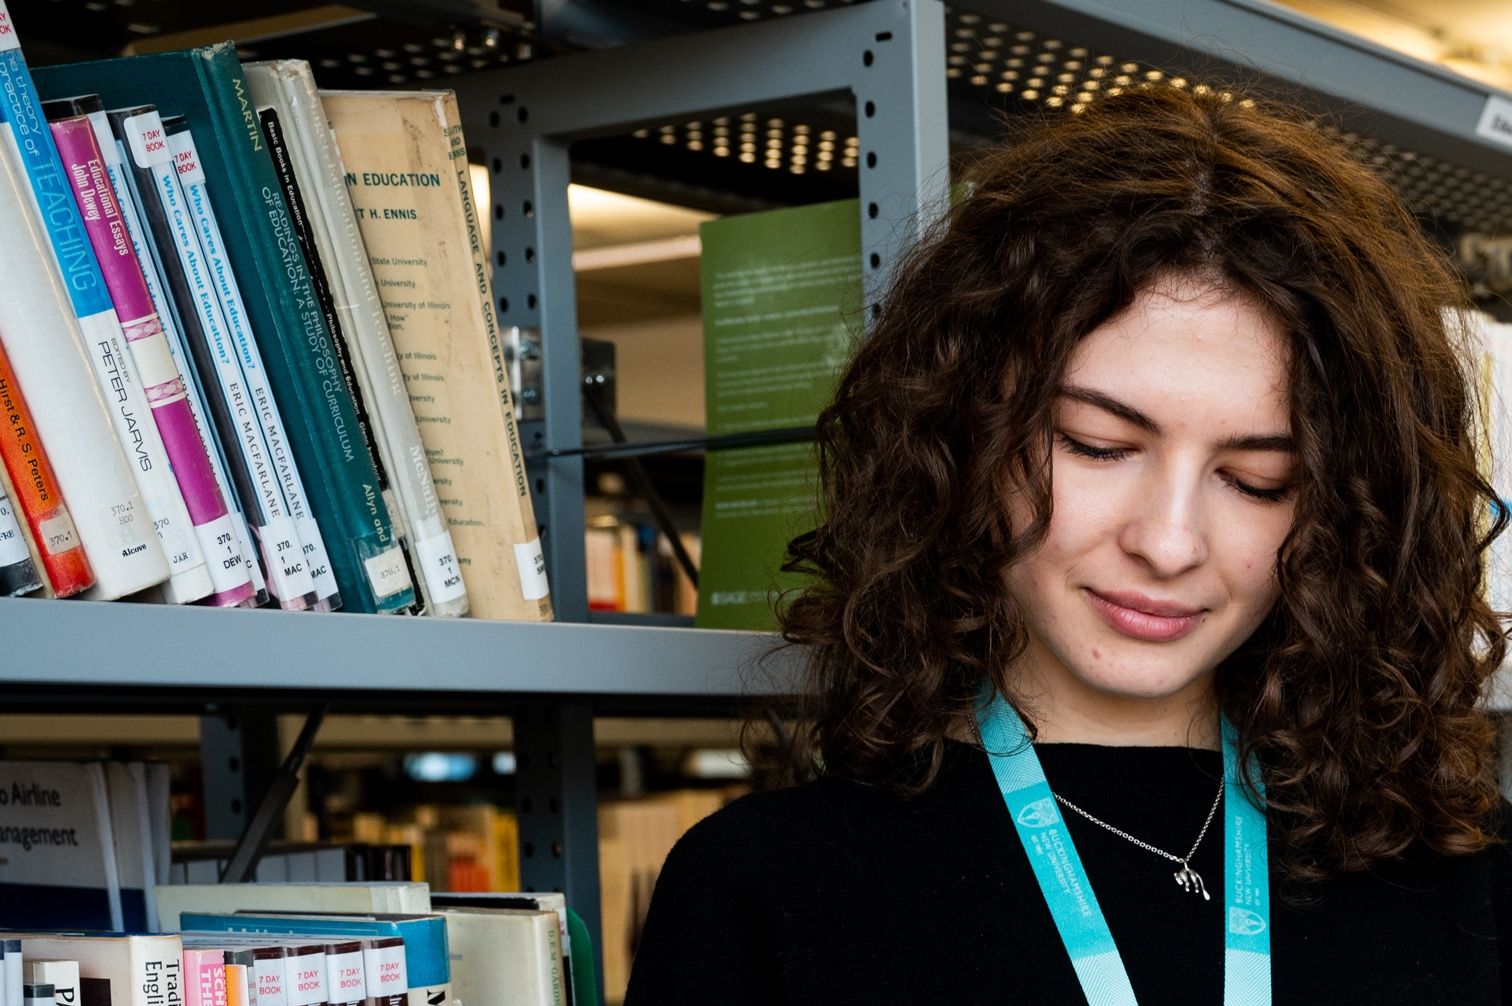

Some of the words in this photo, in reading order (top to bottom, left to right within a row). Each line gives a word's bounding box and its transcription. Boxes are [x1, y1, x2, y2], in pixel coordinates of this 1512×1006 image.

[0, 62, 30, 136] practice
[25, 139, 41, 157] of
[15, 75, 42, 135] theory
[232, 77, 262, 153] MARTIN
[268, 121, 279, 146] Basic
[71, 163, 88, 190] John
[275, 146, 289, 174] Books
[284, 174, 291, 184] in
[364, 173, 441, 187] EDUCATION
[79, 189, 102, 221] Dewey
[87, 159, 118, 219] Educational
[109, 217, 130, 256] Essays
[262, 187, 276, 210] OF
[286, 184, 303, 226] Education
[371, 209, 382, 219] H.
[384, 209, 418, 219] ENNIS
[32, 157, 97, 291] TEACHING
[163, 175, 176, 209] Who
[173, 209, 190, 249] Cares
[186, 249, 205, 295] About
[201, 293, 230, 365] Education?
[268, 209, 301, 296] EDUCATION:
[190, 184, 203, 216] Who
[200, 215, 218, 255] Cares
[213, 256, 232, 302] About
[227, 299, 256, 369] Education?
[297, 299, 308, 310] A
[301, 312, 321, 355] STUDY
[458, 170, 480, 254] LANGUAGE
[475, 262, 487, 295] AND
[483, 302, 505, 383] CONCEPTS
[500, 388, 509, 407] IN
[505, 411, 526, 497] EDUCATION
[315, 355, 329, 378] OF
[0, 379, 13, 412] Hirst
[98, 340, 128, 402] PETER
[121, 406, 153, 473] JARVIS
[11, 414, 20, 423] &
[17, 427, 26, 443] R.
[322, 380, 355, 463] CURRICULUM
[21, 443, 32, 459] S.
[230, 382, 247, 417] ERIC
[242, 420, 281, 519] MACFARLANE
[255, 387, 273, 422] ERIC
[267, 424, 305, 520] MACFARLANE
[27, 459, 49, 502] Peters
[223, 555, 242, 570] DEW
[284, 563, 303, 577] MAC
[11, 781, 62, 807] Airline
[1040, 832, 1052, 850] NEW
[1047, 849, 1071, 896] UNIVERSITY
[1049, 828, 1093, 918] BUCKINGHAMSHIRE
[1235, 815, 1243, 904] BUCKINGHAMSHIRE
